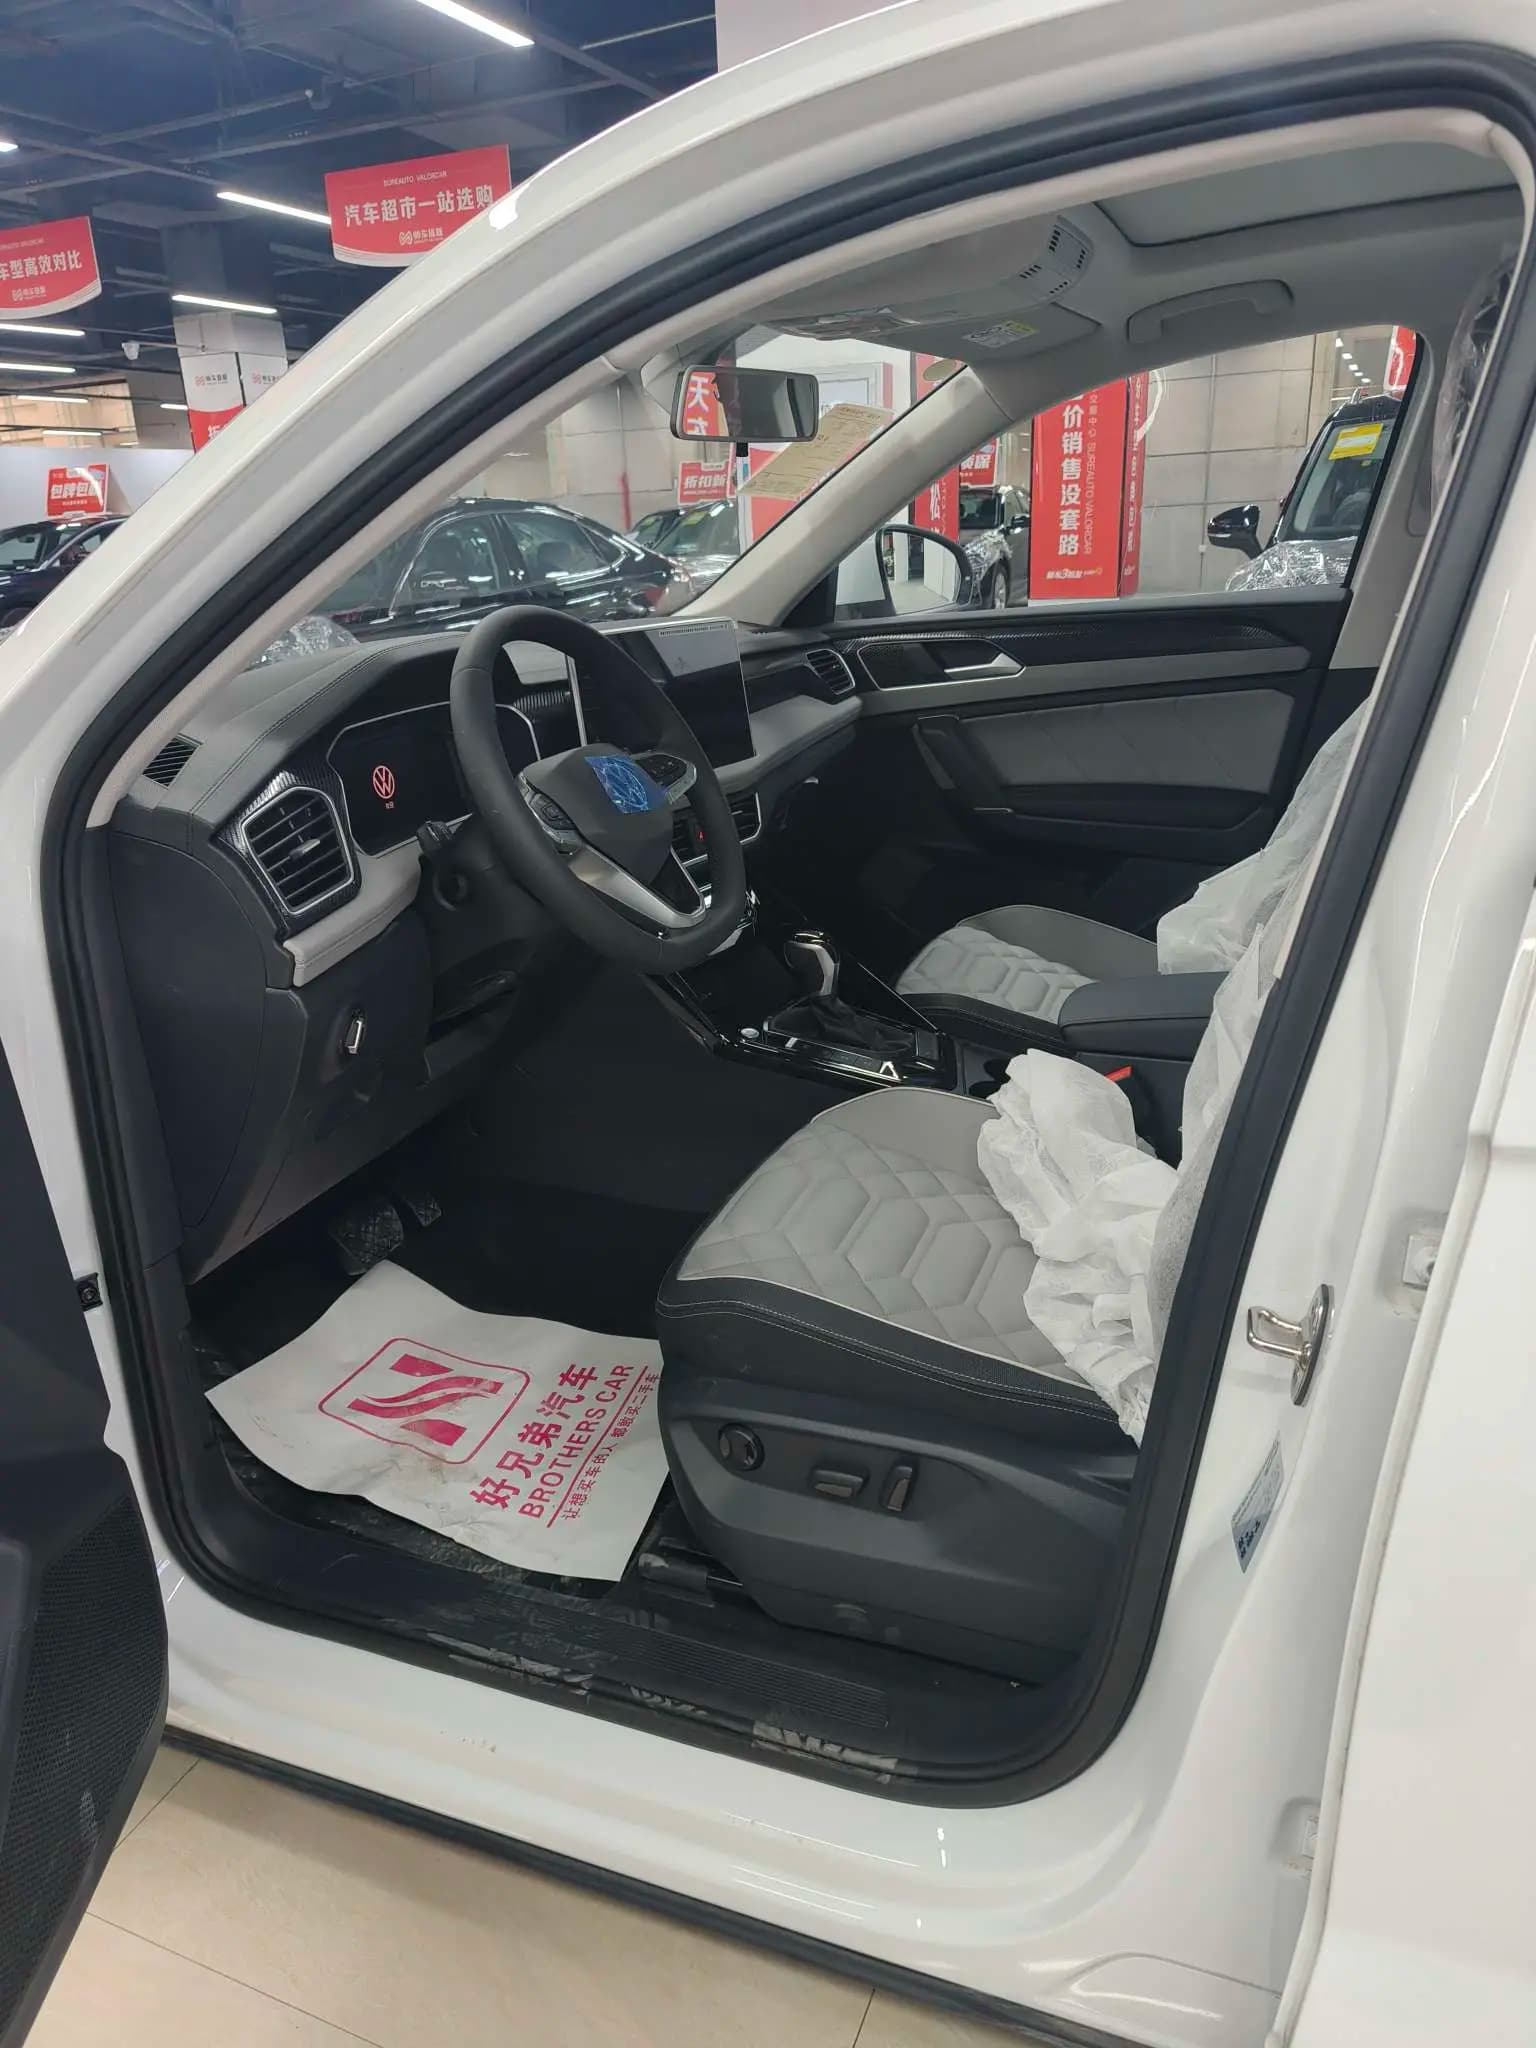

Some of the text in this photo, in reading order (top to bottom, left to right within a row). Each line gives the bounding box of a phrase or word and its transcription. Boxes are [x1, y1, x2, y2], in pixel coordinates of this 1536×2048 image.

[344, 184, 493, 227] 汽车超市一站选购
[1058, 394, 1085, 556] 价销售没套路
[469, 1364, 598, 1510] 好兄弟汽车
[518, 1364, 634, 1519] BROTHERS CAR
